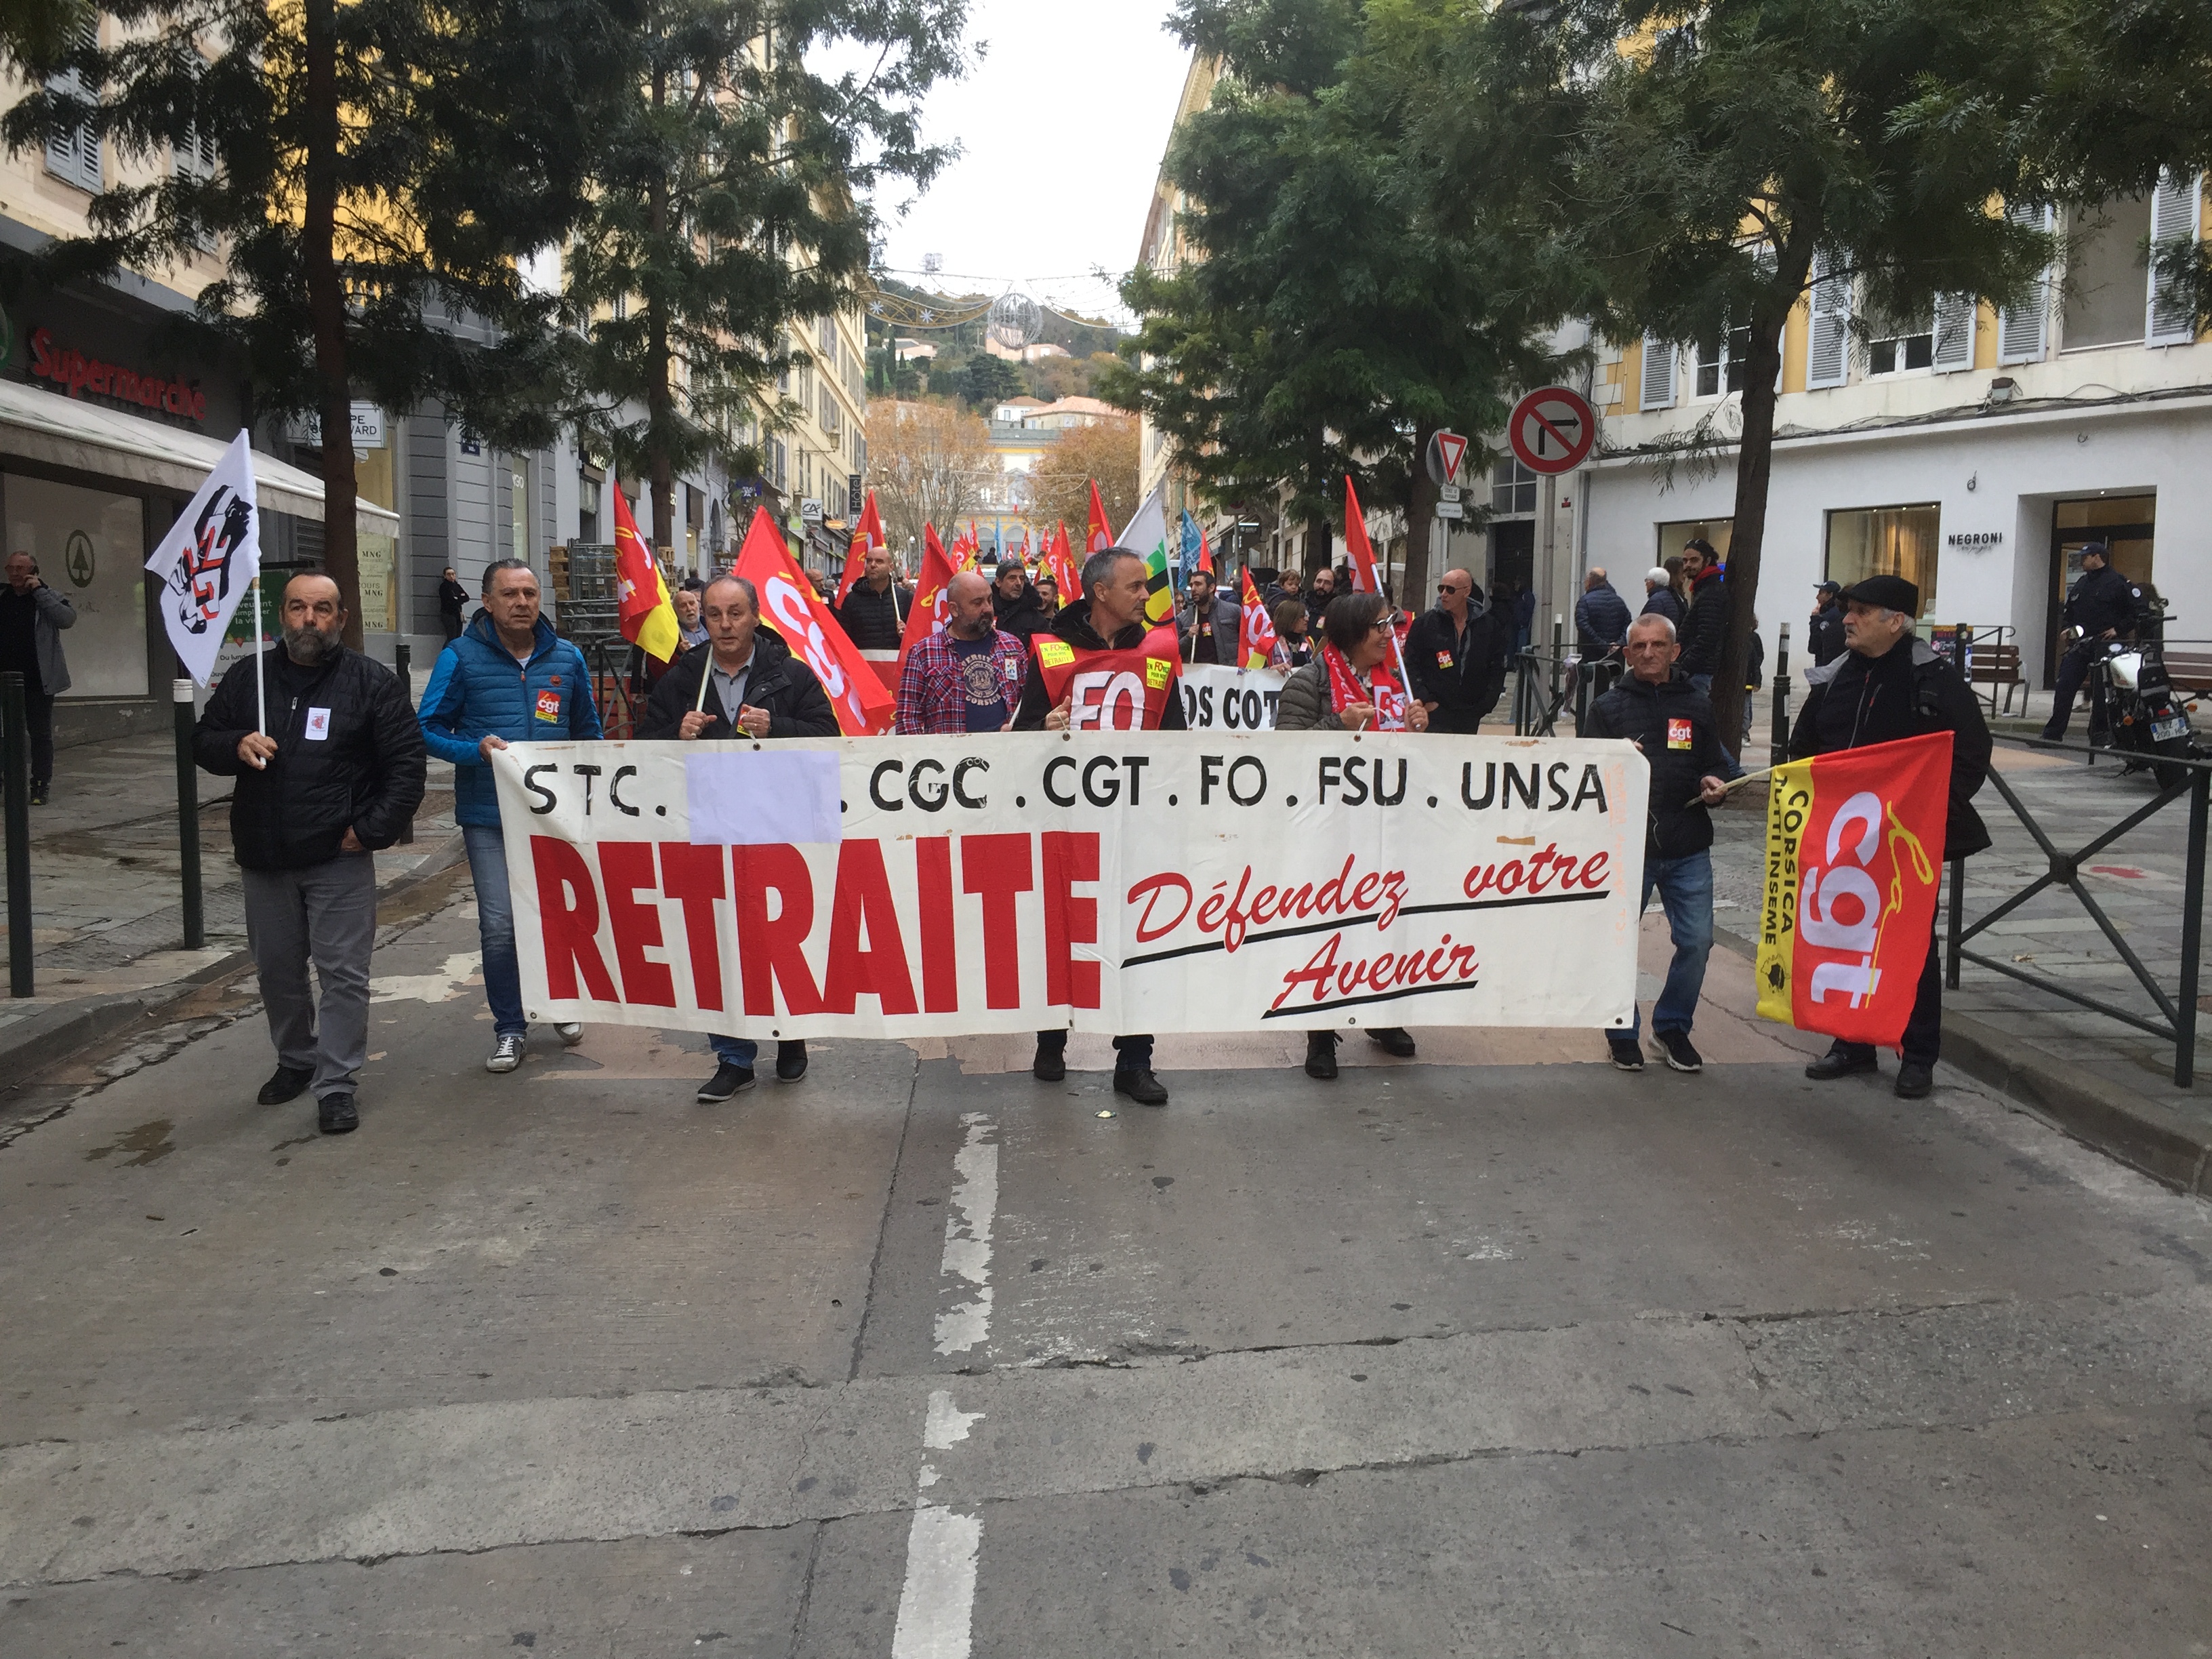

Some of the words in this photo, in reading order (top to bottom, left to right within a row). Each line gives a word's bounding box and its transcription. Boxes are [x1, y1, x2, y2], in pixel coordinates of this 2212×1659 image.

[851, 476, 861, 508] Hôtel
[1948, 532, 2003, 545] NEGRONI
[538, 699, 559, 713] cgt
[966, 694, 1001, 705] CORSICA
[1069, 671, 1145, 731] FO
[1669, 726, 1691, 741] cgt
[869, 757, 989, 813] CGC
[1042, 755, 1149, 808] CGT
[1200, 755, 1267, 806] FO
[1318, 756, 1407, 806] FSU
[1461, 761, 1608, 813] UNSA
[1769, 775, 1788, 842] TUTTI
[1780, 790, 1809, 934] CORSICA
[531, 831, 1101, 1016] RETRAITE
[1127, 853, 1408, 952] Défendez
[1463, 842, 1611, 899] votre
[1765, 851, 1784, 945] INSEME
[1800, 791, 1883, 1009] cgt
[1271, 932, 1479, 1011] Avenir
